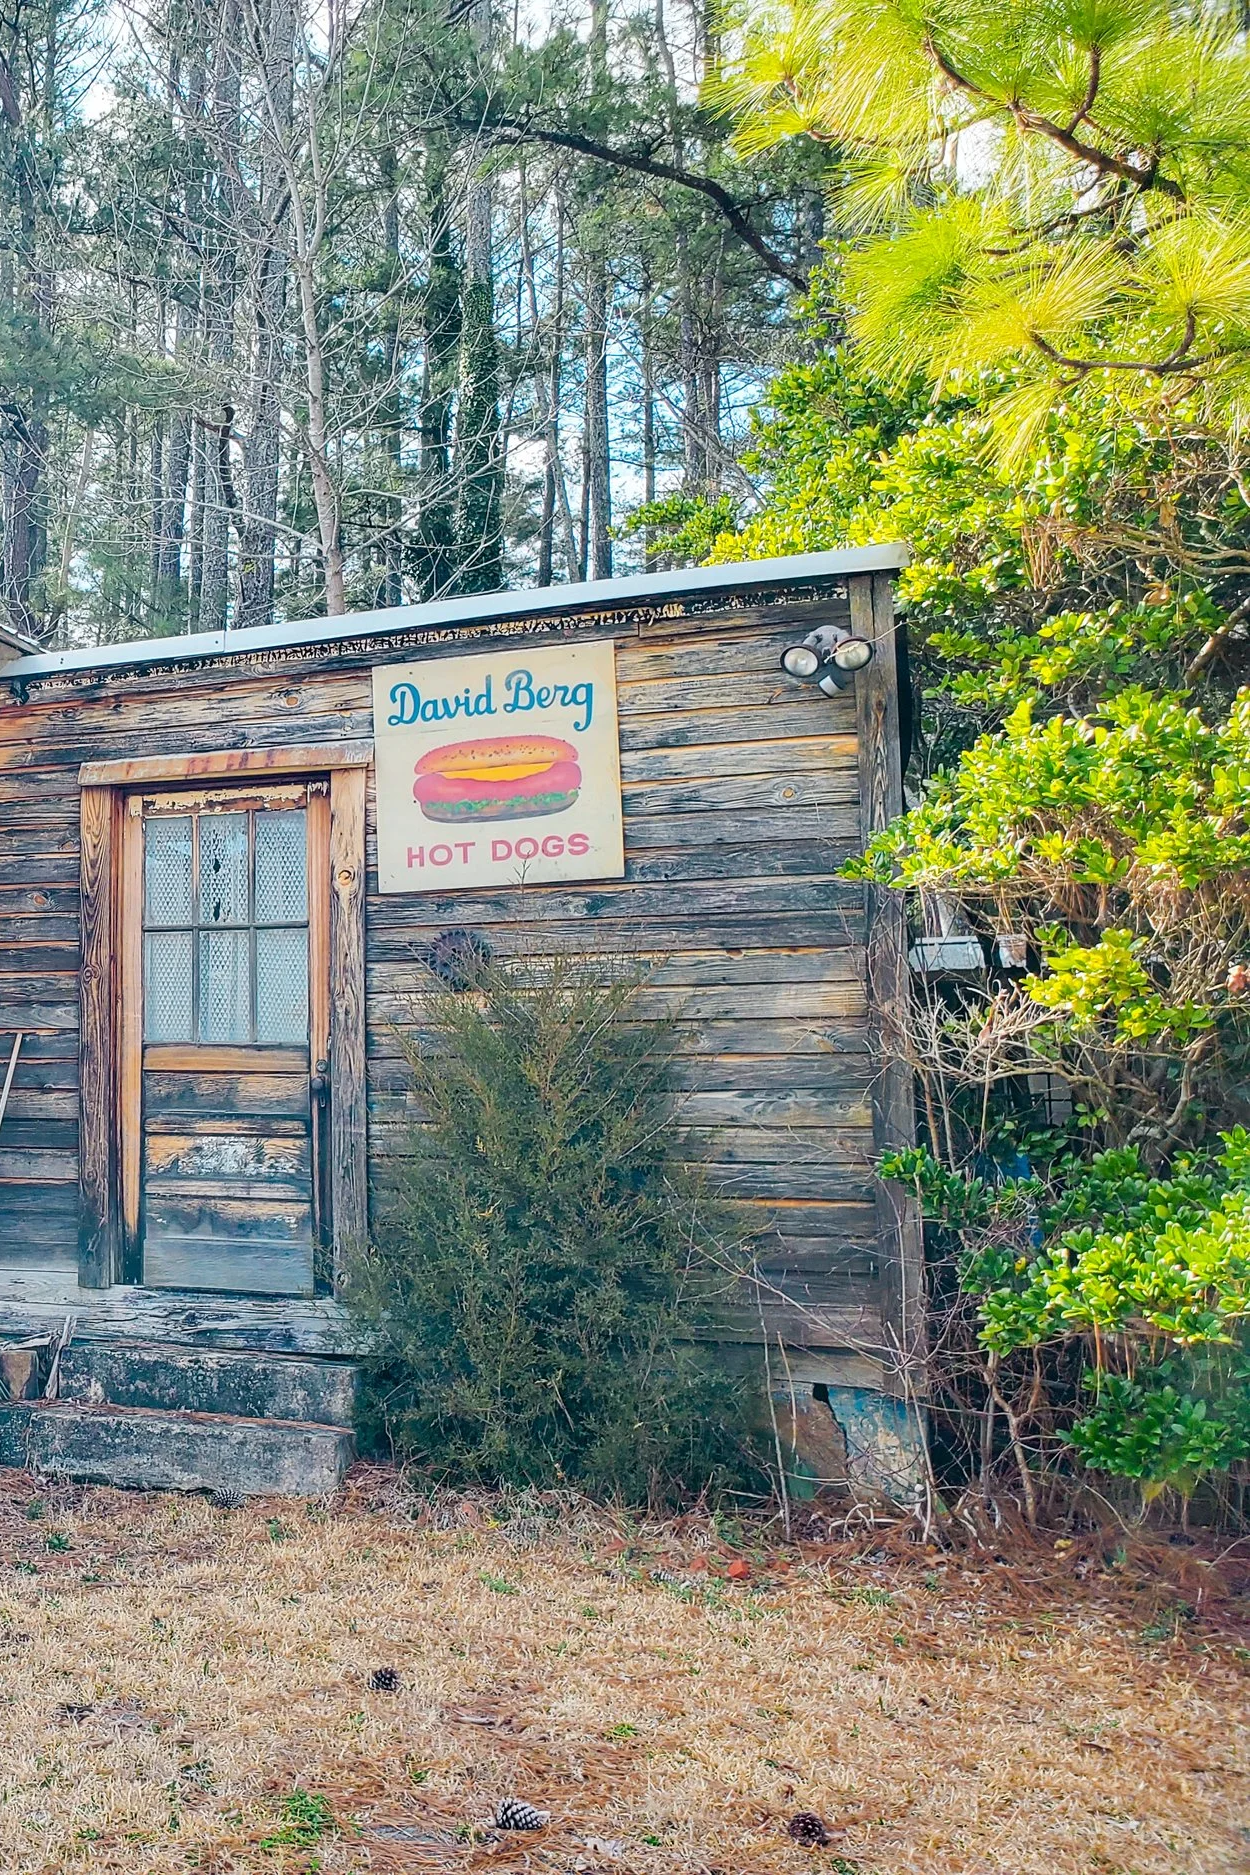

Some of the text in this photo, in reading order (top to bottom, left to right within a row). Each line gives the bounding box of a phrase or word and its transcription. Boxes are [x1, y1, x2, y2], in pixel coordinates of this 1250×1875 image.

[388, 669, 593, 732] David Berg
[407, 833, 590, 869] HOT DOGS
